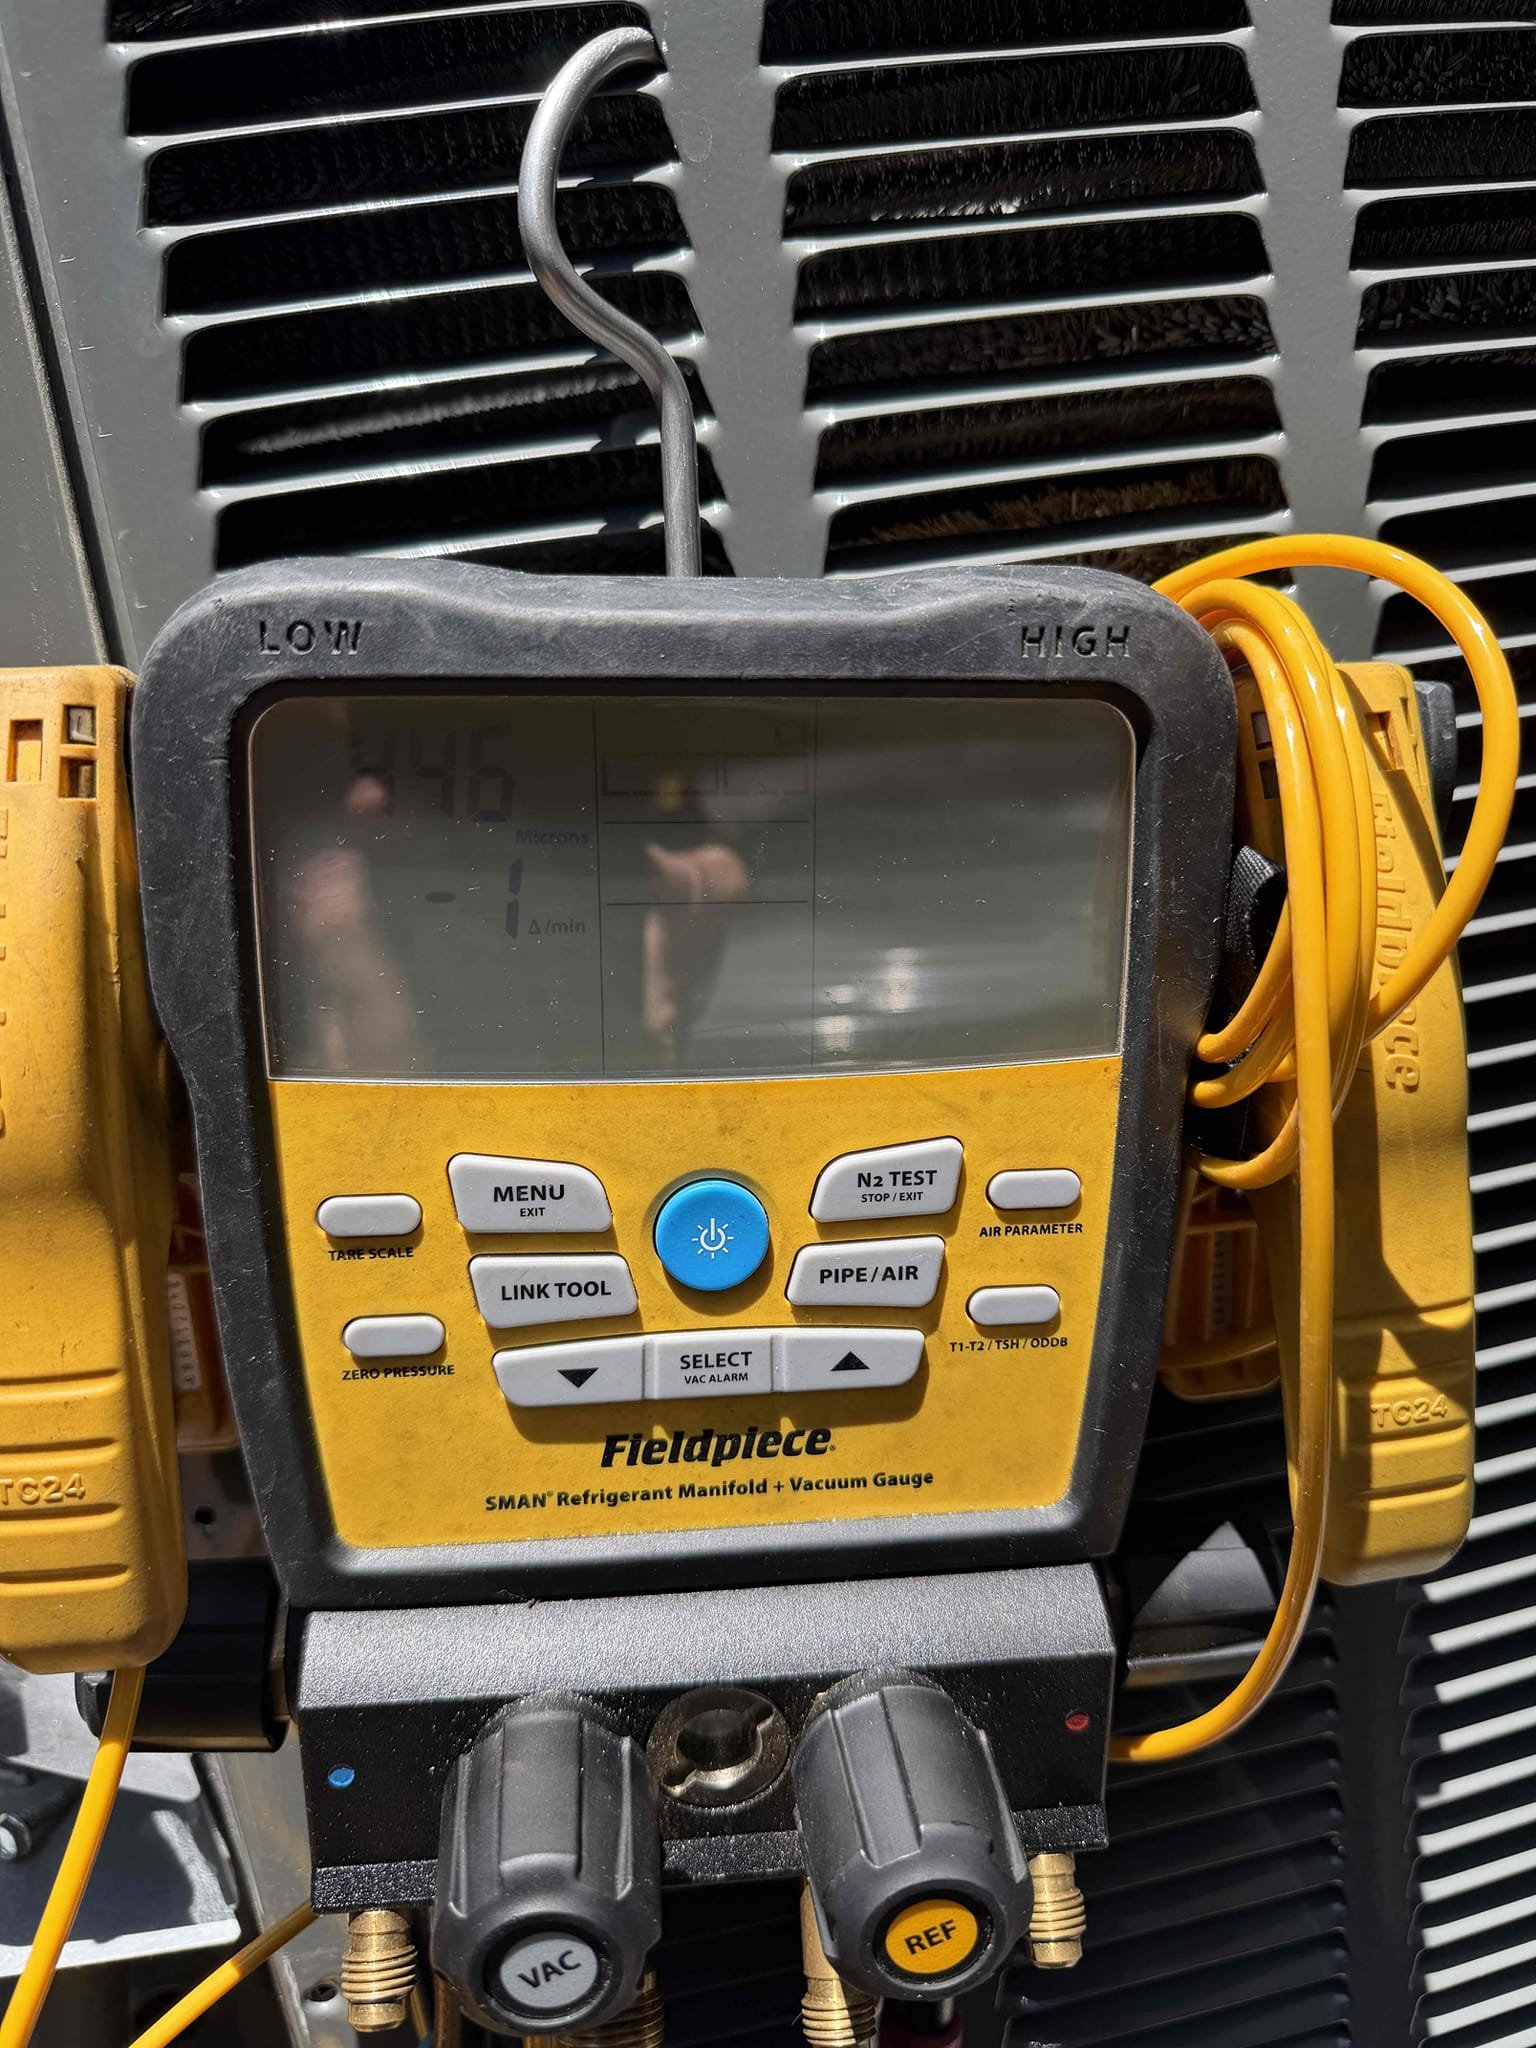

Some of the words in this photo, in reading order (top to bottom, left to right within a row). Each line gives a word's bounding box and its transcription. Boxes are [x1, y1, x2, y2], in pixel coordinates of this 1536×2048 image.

[258, 620, 363, 656] LOW
[1021, 626, 1131, 658] HIGH
[515, 829, 591, 846] Microns
[889, 1169, 938, 1187] TEST
[493, 1184, 566, 1203] MENU
[861, 1193, 890, 1204] STOP
[899, 1192, 924, 1203] EXIT
[519, 1207, 546, 1218] EXIT
[979, 1227, 1002, 1238] AIR
[1004, 1223, 1083, 1236] PARAMETER
[328, 1249, 365, 1261] TARE
[369, 1247, 414, 1259] SCALE
[501, 1284, 550, 1301] LINK
[554, 1280, 612, 1298] TOOL
[950, 1341, 985, 1352] T1-T2
[995, 1339, 1020, 1350] TSH
[1030, 1337, 1068, 1348] ODDB
[680, 1351, 753, 1370] SELECT
[342, 1368, 380, 1381] ZERO
[384, 1364, 455, 1378] PRESSURE
[684, 1374, 708, 1385] VAC
[709, 1371, 749, 1384] ALARM
[1371, 1394, 1448, 1428] TC24
[557, 1486, 673, 1510] Refrigerant
[678, 1478, 767, 1498] Manifold
[790, 1475, 870, 1492] Vacuum
[873, 1470, 934, 1490] Gauge
[904, 1919, 957, 1956] REF
[518, 1949, 582, 1988] VAC
